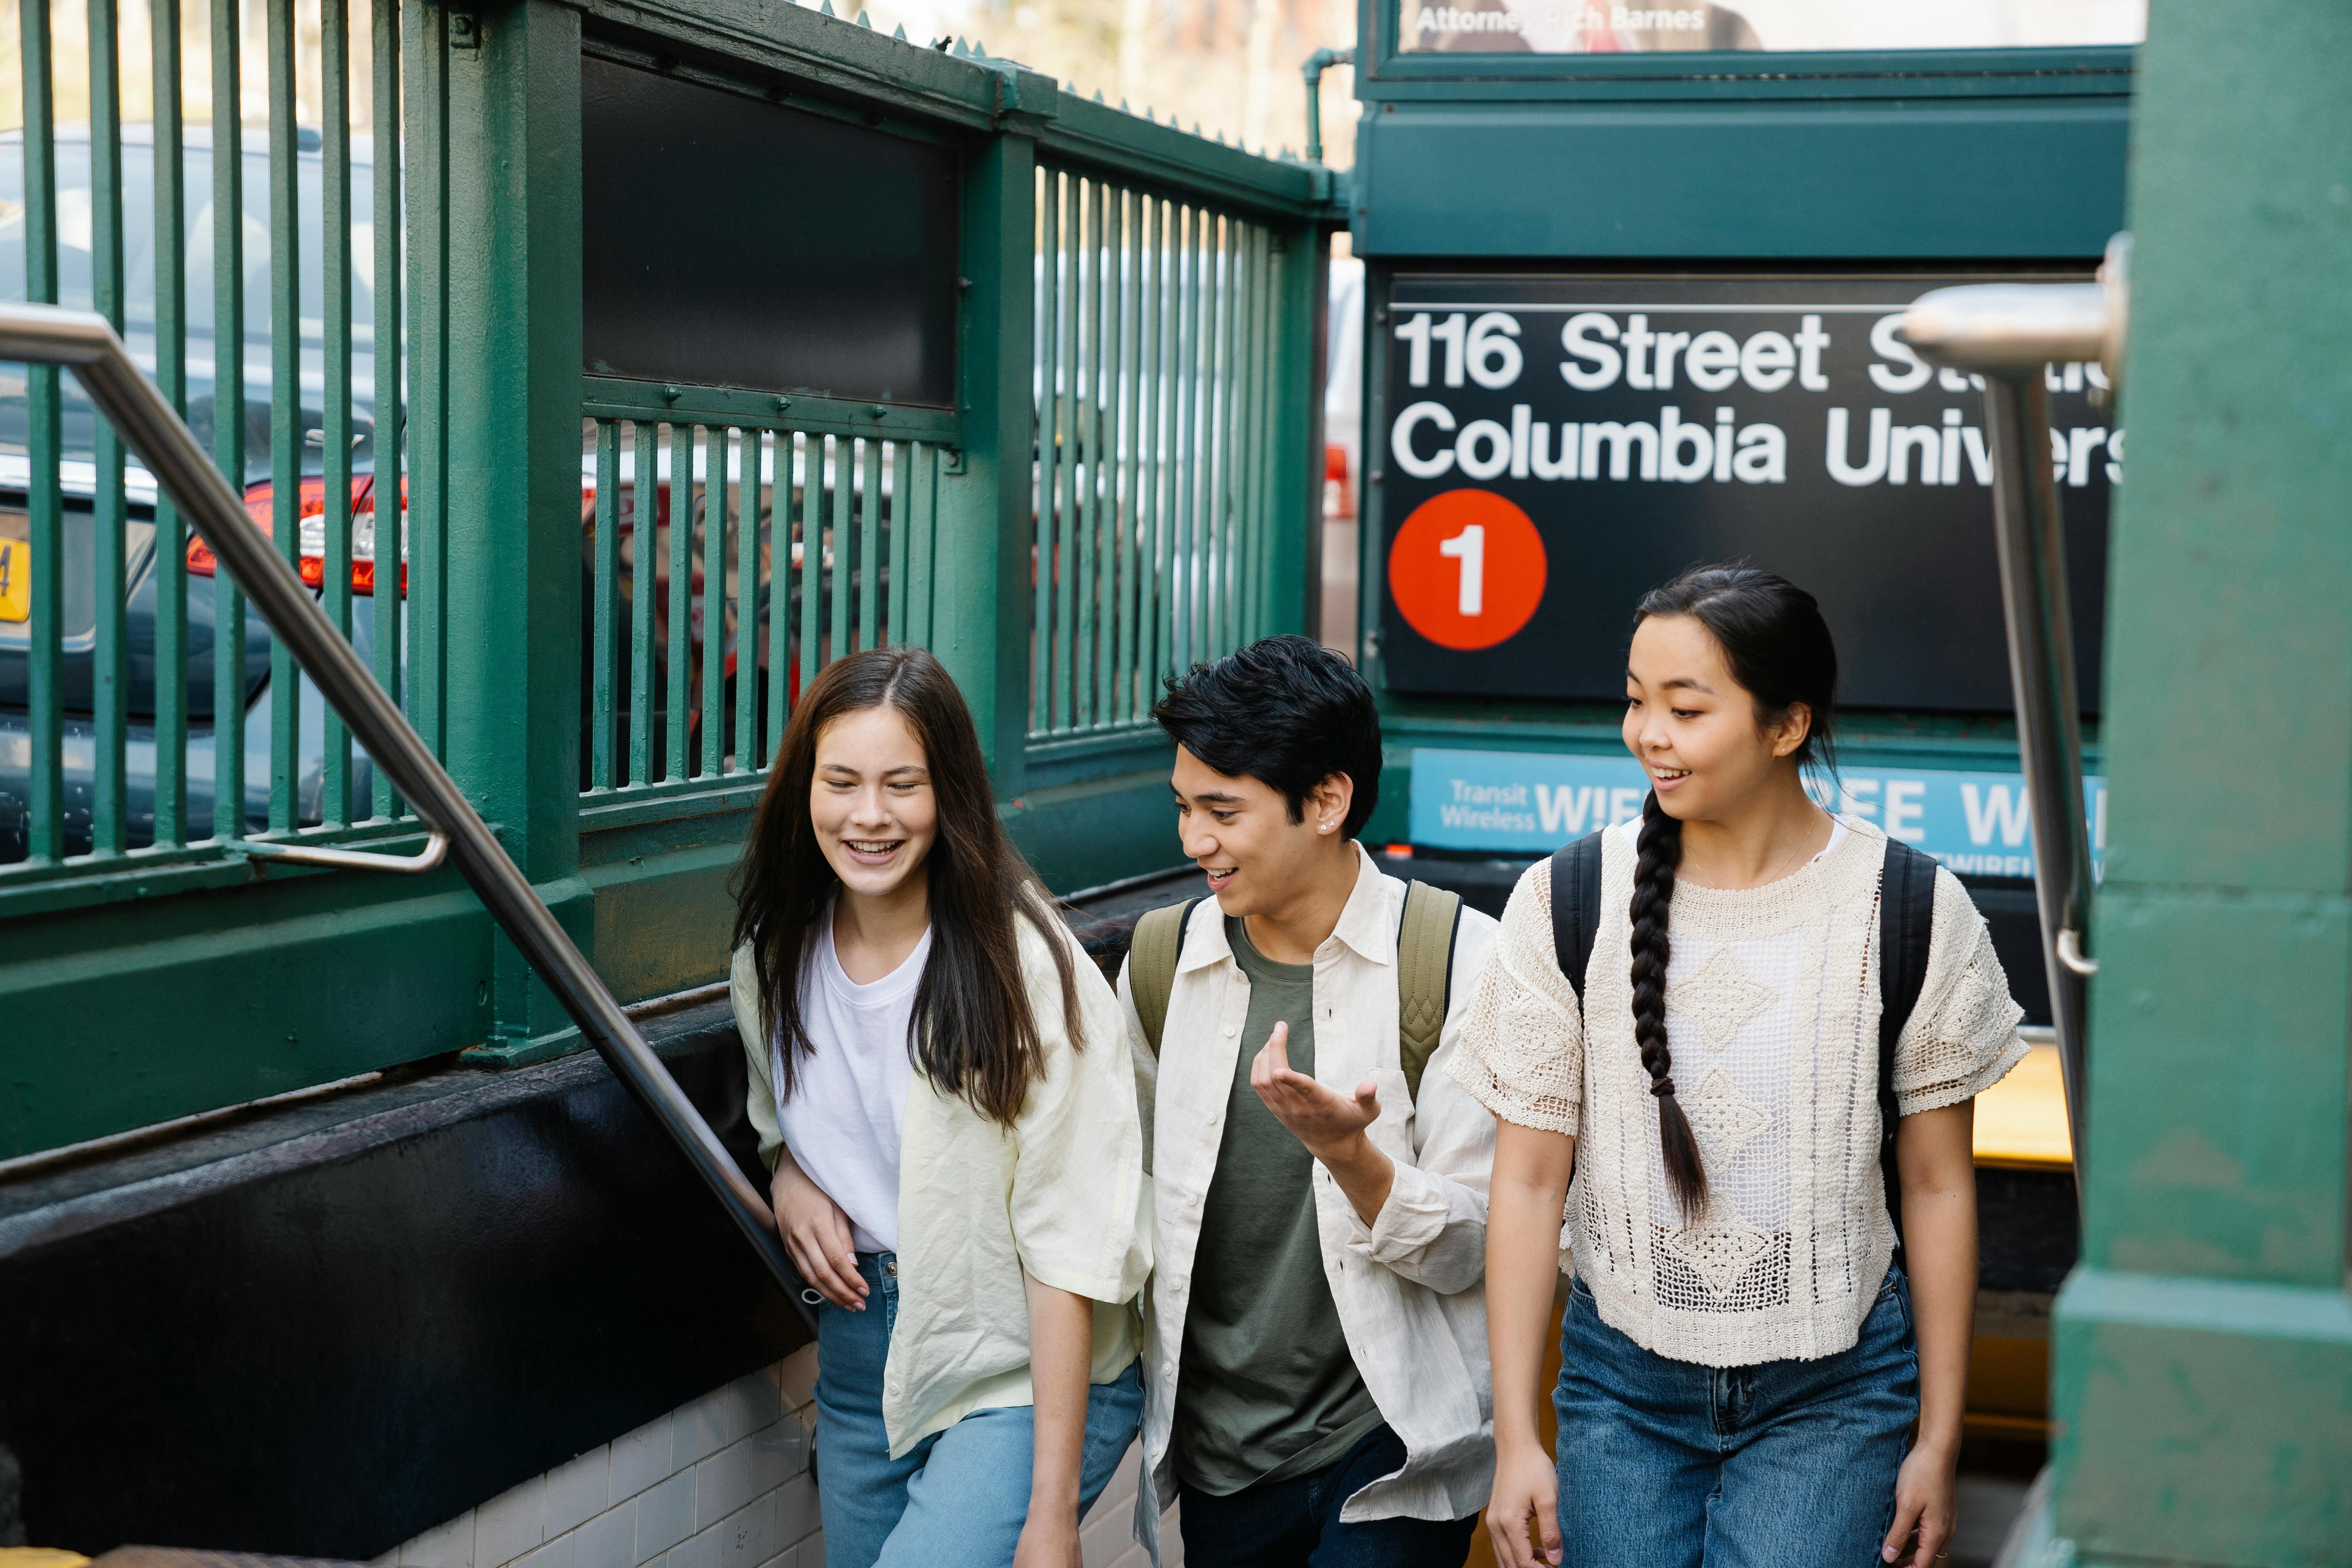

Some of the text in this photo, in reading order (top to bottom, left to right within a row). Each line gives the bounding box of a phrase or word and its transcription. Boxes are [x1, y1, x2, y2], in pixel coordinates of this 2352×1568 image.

[1416, 6, 1531, 38] Attorney
[1611, 6, 1706, 29] Barnes
[1394, 311, 1524, 390] 116
[1559, 312, 1831, 392] Street
[1390, 401, 1786, 485] Columbia
[1439, 524, 1485, 617] 1
[1439, 805, 1536, 832] Wireless
[1451, 779, 1528, 806] Transit
